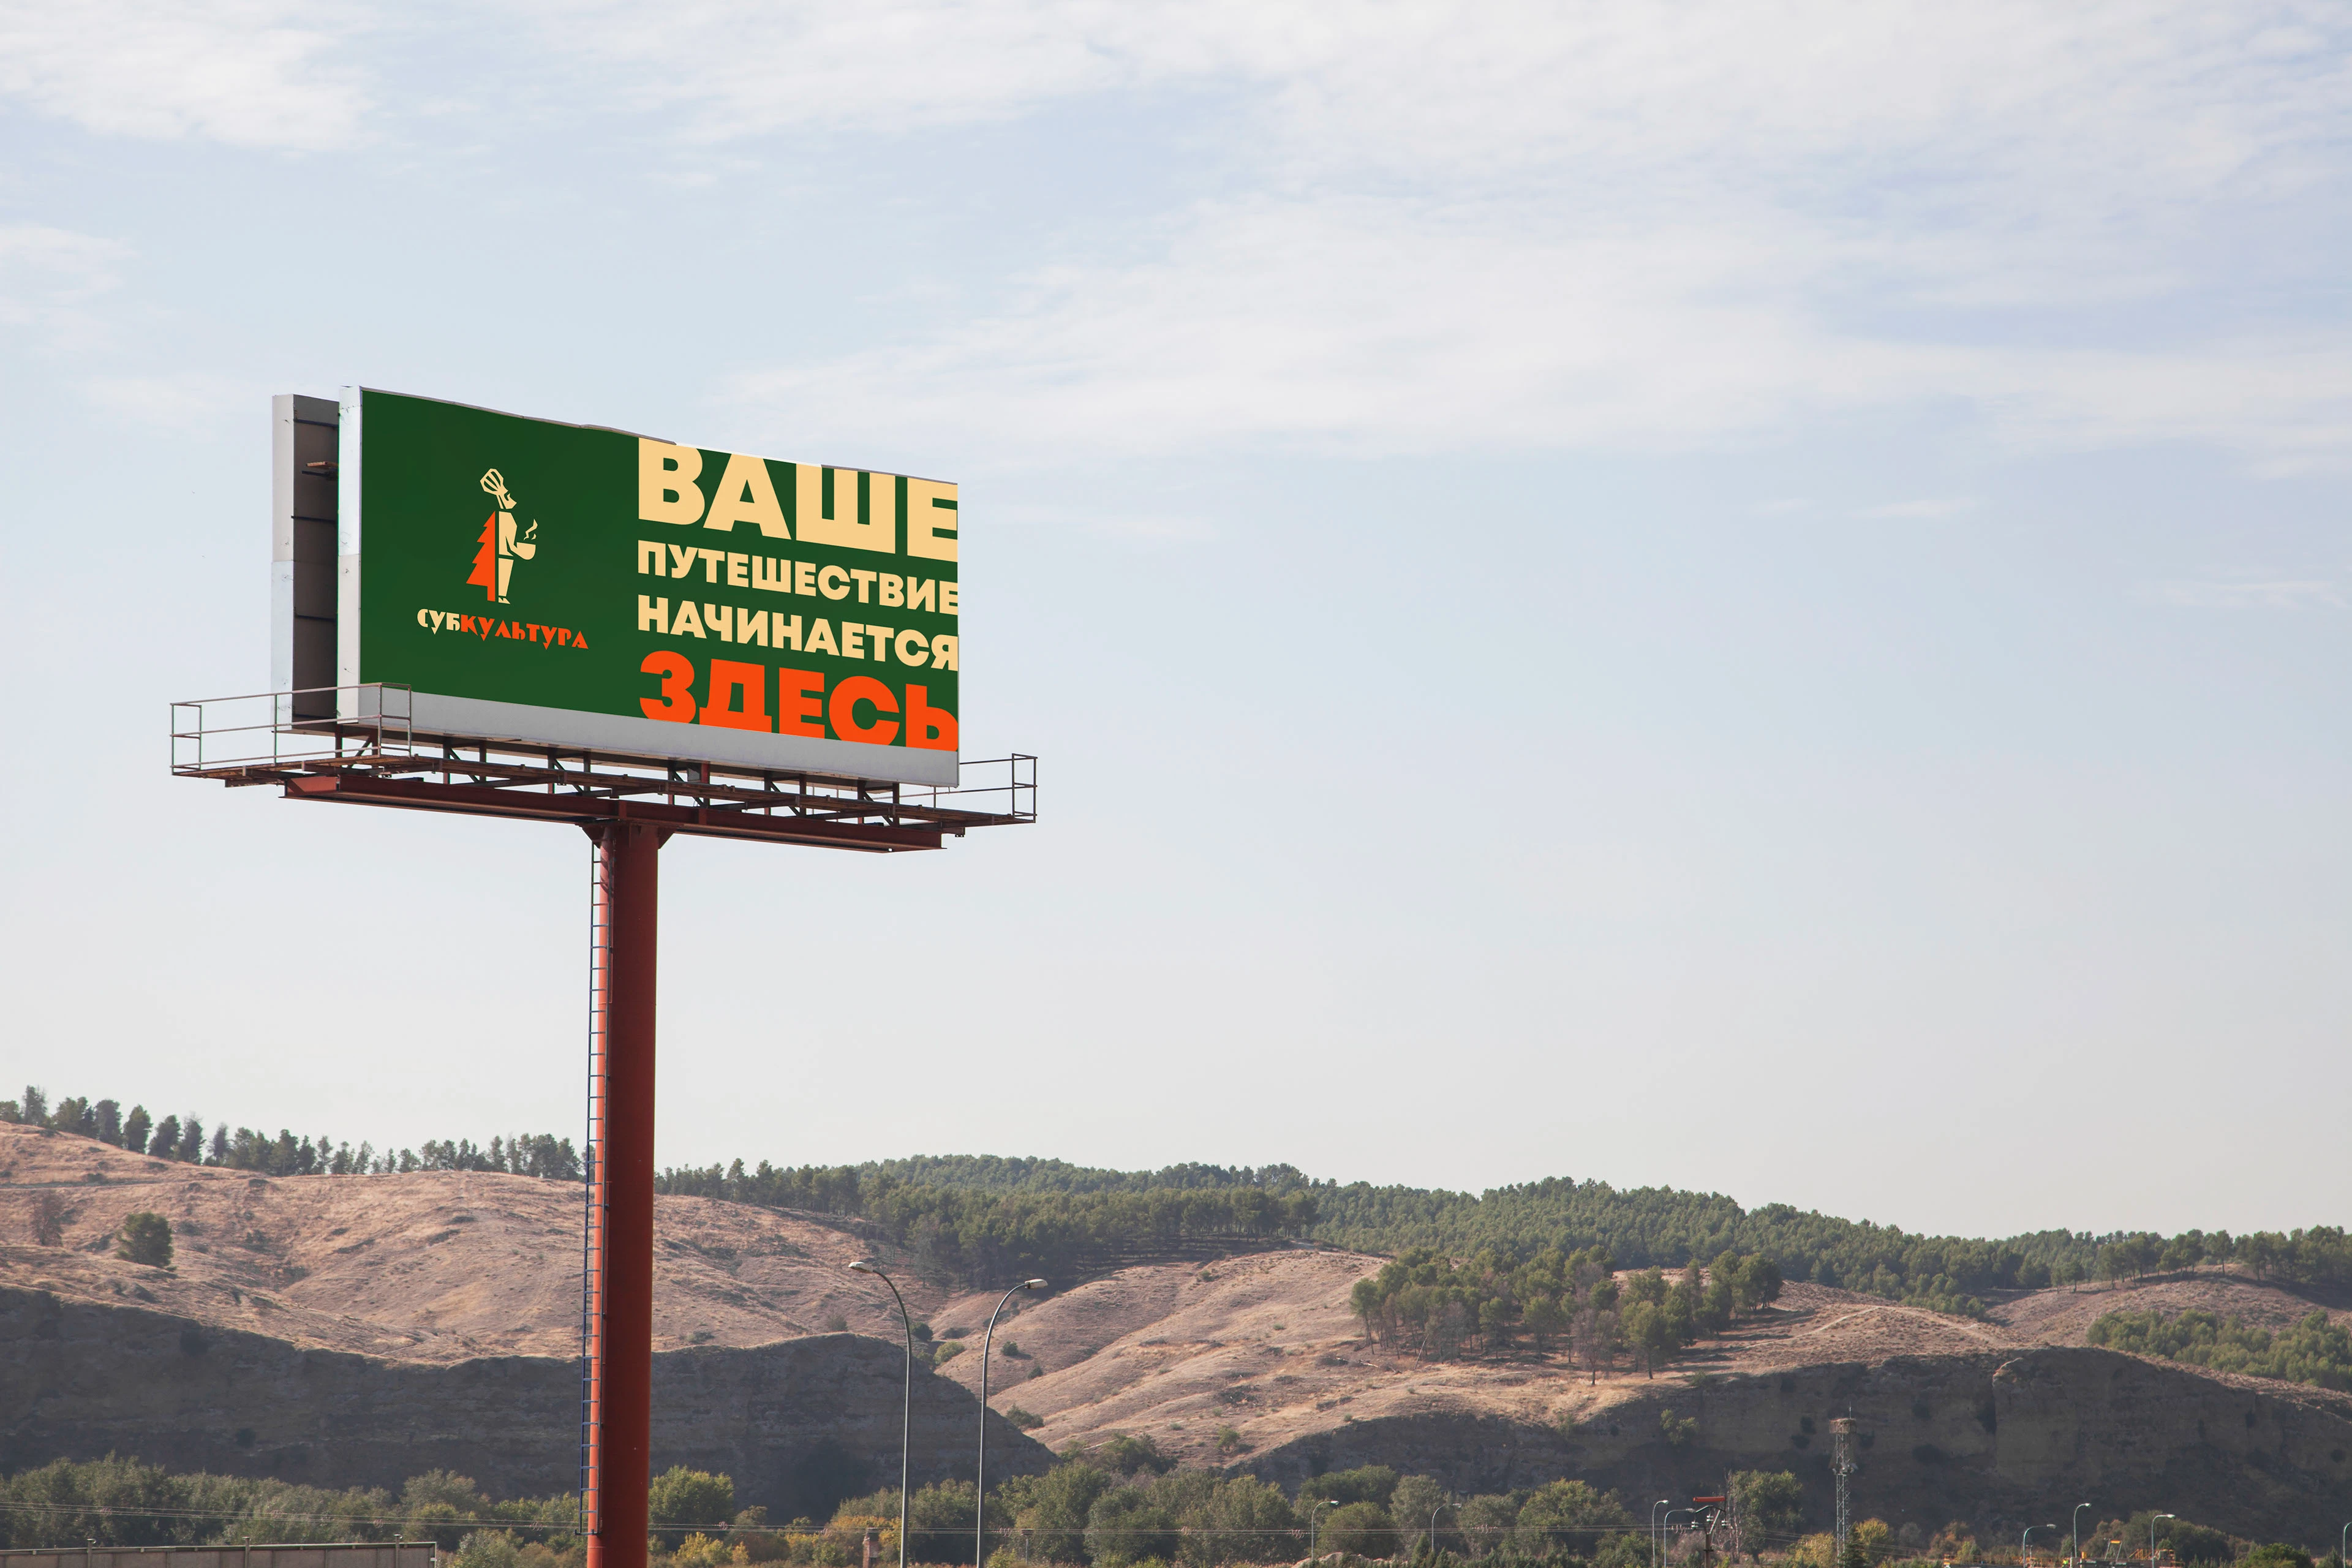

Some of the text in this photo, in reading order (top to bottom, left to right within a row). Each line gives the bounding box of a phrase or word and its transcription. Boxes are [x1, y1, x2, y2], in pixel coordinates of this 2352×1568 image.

[638, 437, 958, 562] ВАШЕ
[638, 540, 958, 616] ПУТЕШЕСТВИЕ
[417, 608, 589, 650] СУБКУЛЬТУРА
[638, 594, 958, 671] НАЧИНАЕТСЯ
[639, 650, 959, 752] ЗДЕСЬ
